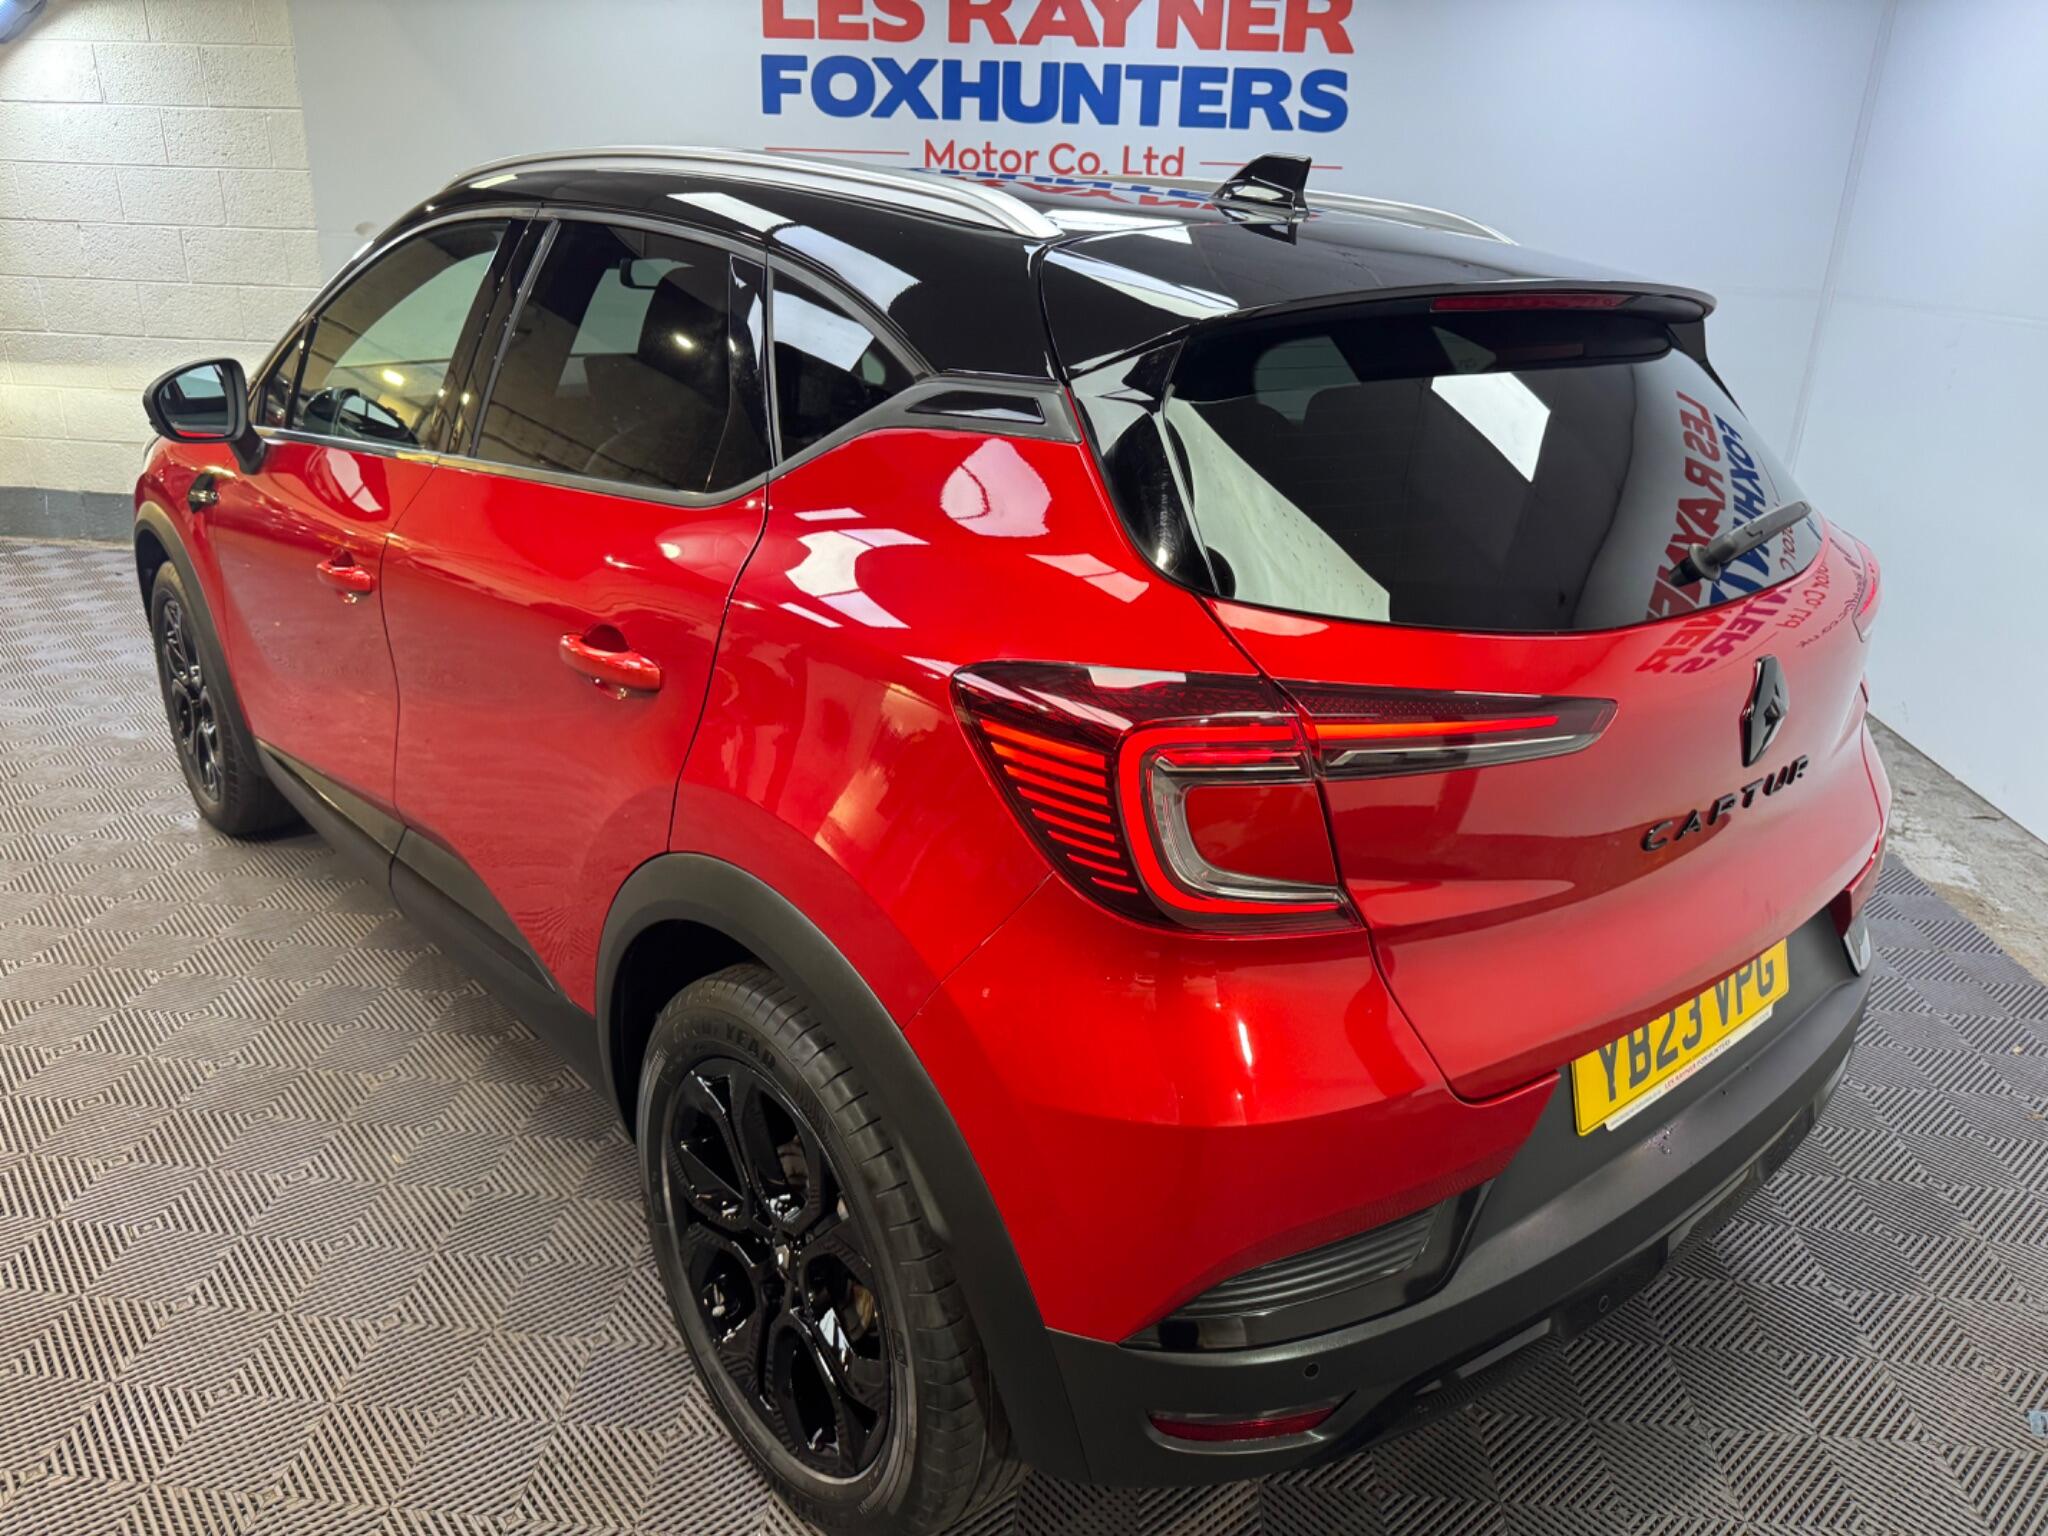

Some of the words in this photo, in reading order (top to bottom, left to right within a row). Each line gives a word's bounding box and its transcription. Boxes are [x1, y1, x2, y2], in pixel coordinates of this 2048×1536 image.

[762, 0, 925, 42] LES
[949, 0, 1354, 53] RAYNER
[761, 55, 1348, 132] FOXHUNTERS
[925, 140, 1038, 175] Motor
[1049, 144, 1109, 176] Co.
[1123, 145, 1185, 177] Ltd
[1640, 754, 1808, 851] CAPTUR
[1598, 998, 1703, 1102] YB23
[1714, 953, 1775, 1027] VPG
